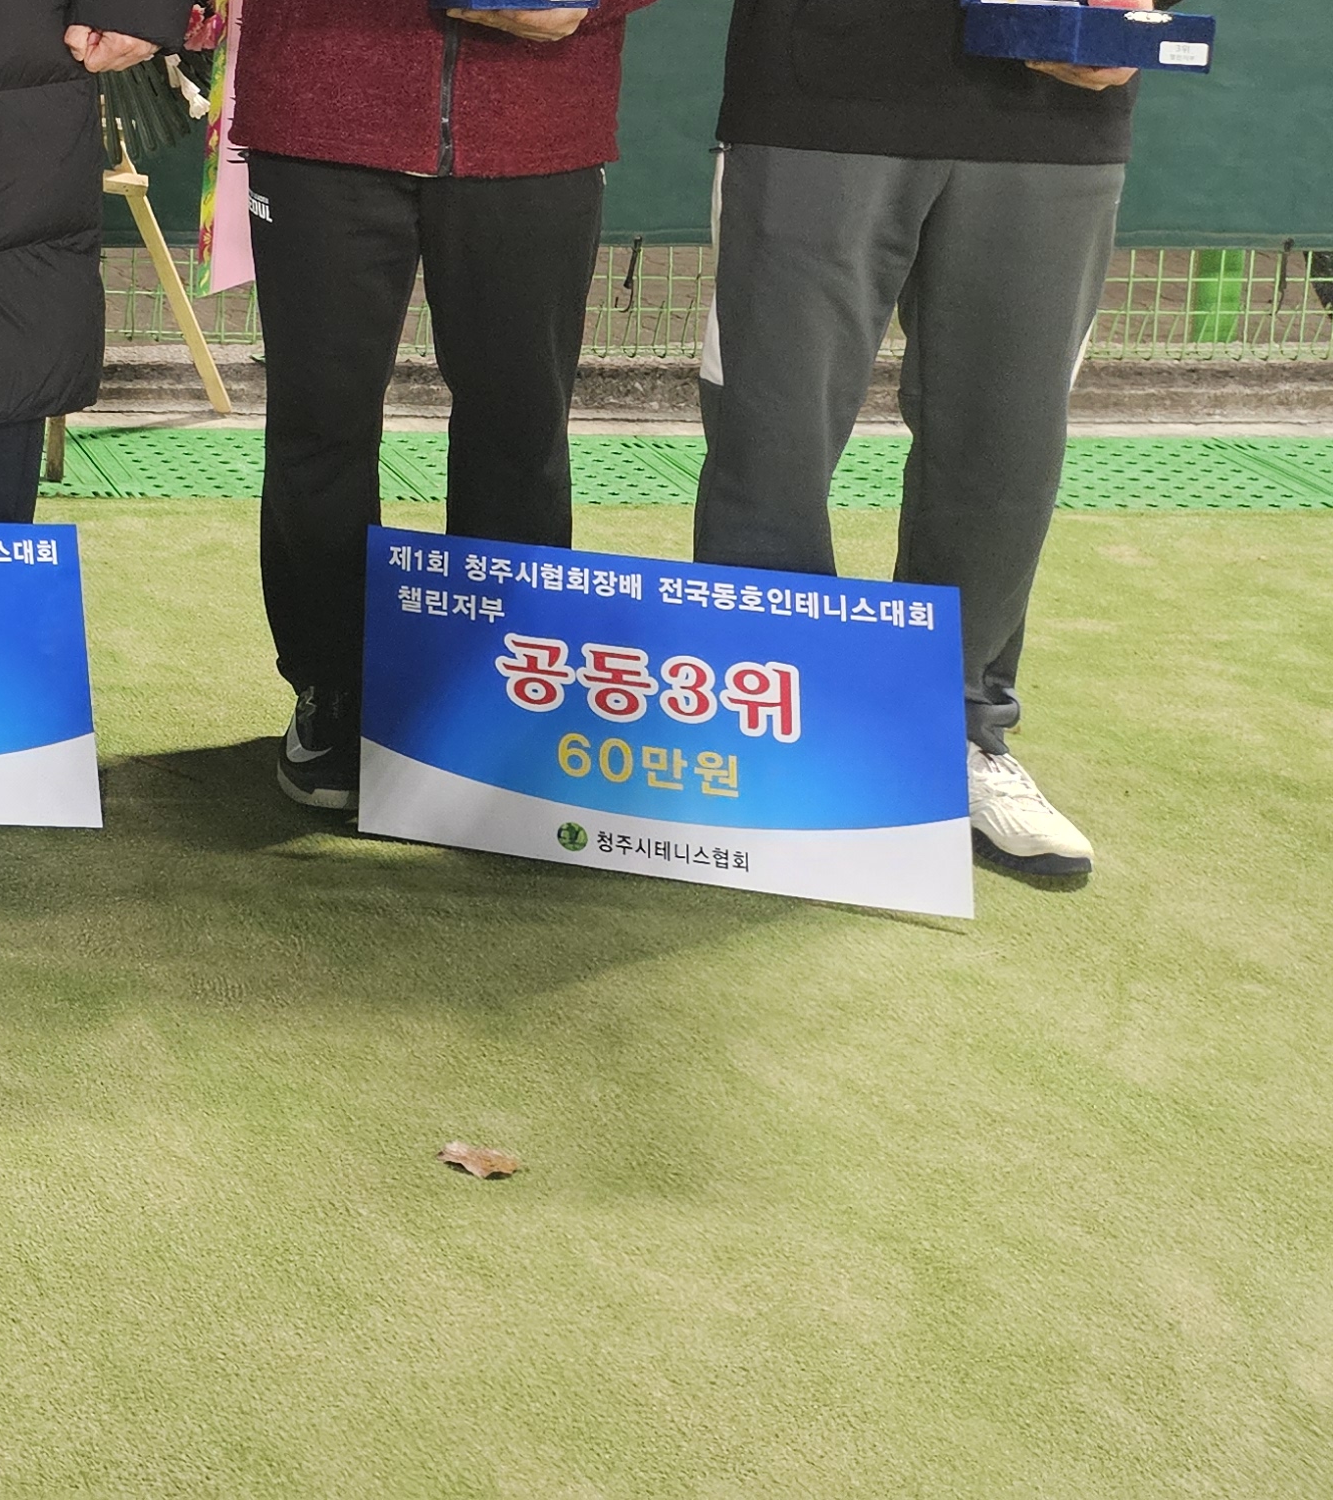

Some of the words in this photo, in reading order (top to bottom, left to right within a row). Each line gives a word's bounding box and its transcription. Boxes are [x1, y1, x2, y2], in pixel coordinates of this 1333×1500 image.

[389, 545, 449, 578] 제1회
[464, 553, 643, 601] 청주시협회장배
[658, 576, 935, 631] 전국동호인테니스대회
[397, 585, 506, 622] 챌린저부
[495, 631, 801, 744] 공동3위
[557, 732, 740, 798] 60만원
[597, 830, 750, 872] 청주시테니스협회
